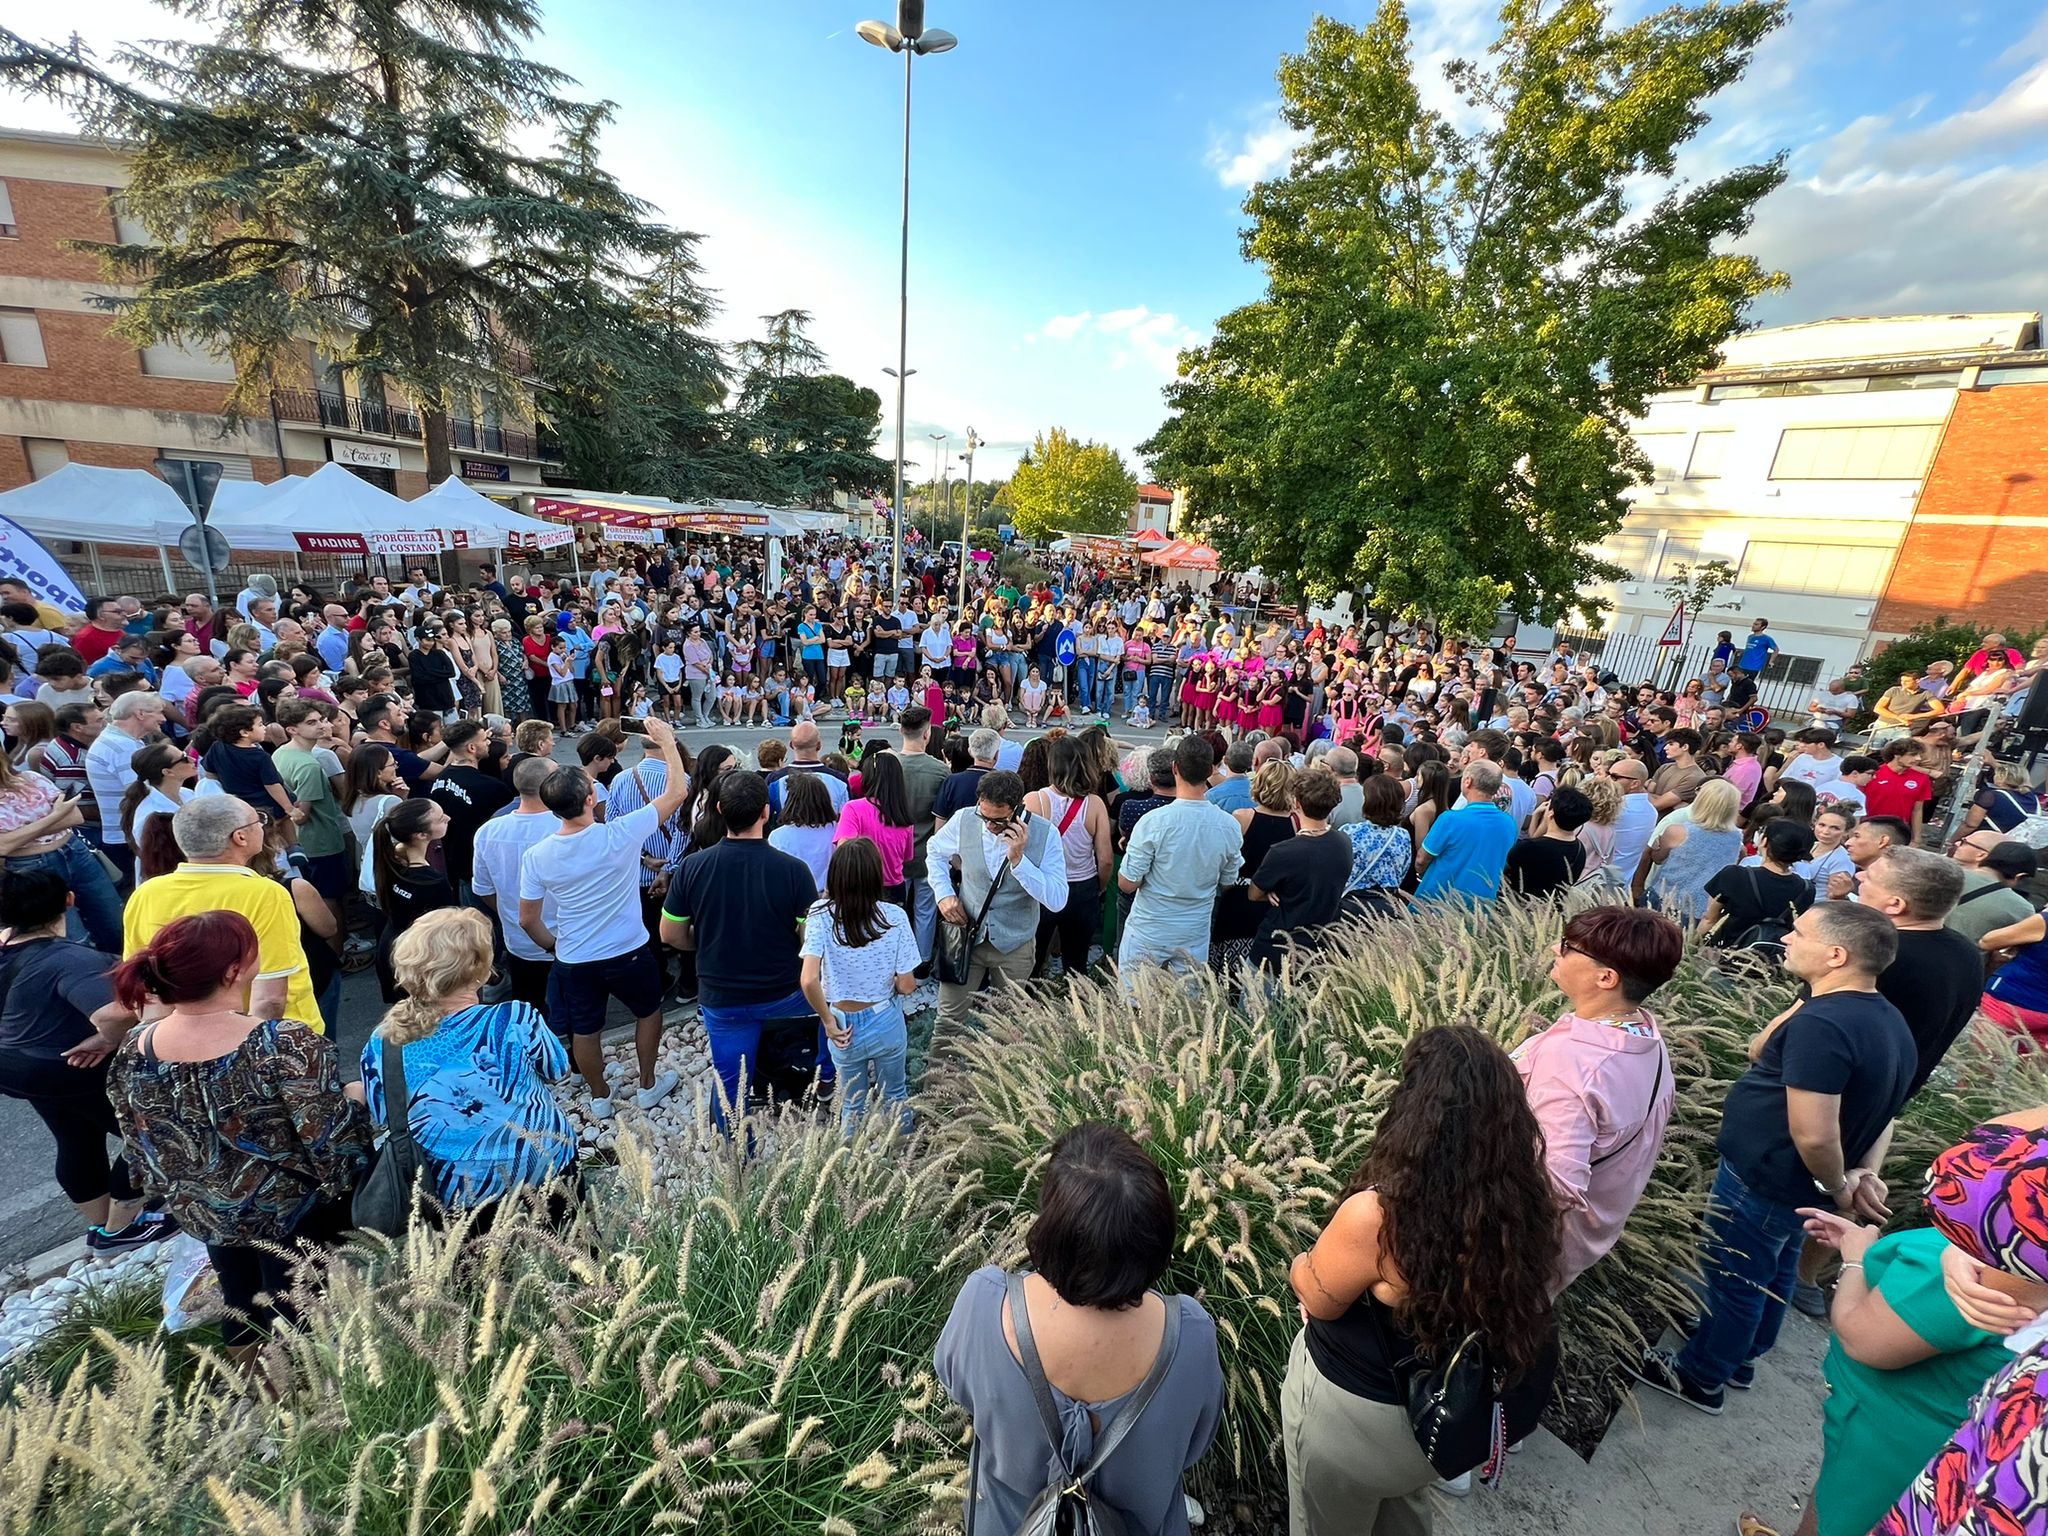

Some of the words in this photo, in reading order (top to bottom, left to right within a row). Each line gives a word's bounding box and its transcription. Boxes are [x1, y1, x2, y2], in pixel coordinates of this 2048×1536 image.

[308, 537, 360, 548] PIADINE
[375, 533, 436, 542] PORCHETTA
[539, 530, 574, 547] PORCHETTA
[378, 543, 387, 552] di
[390, 544, 436, 552] COSTANO
[445, 778, 472, 805] Angels
